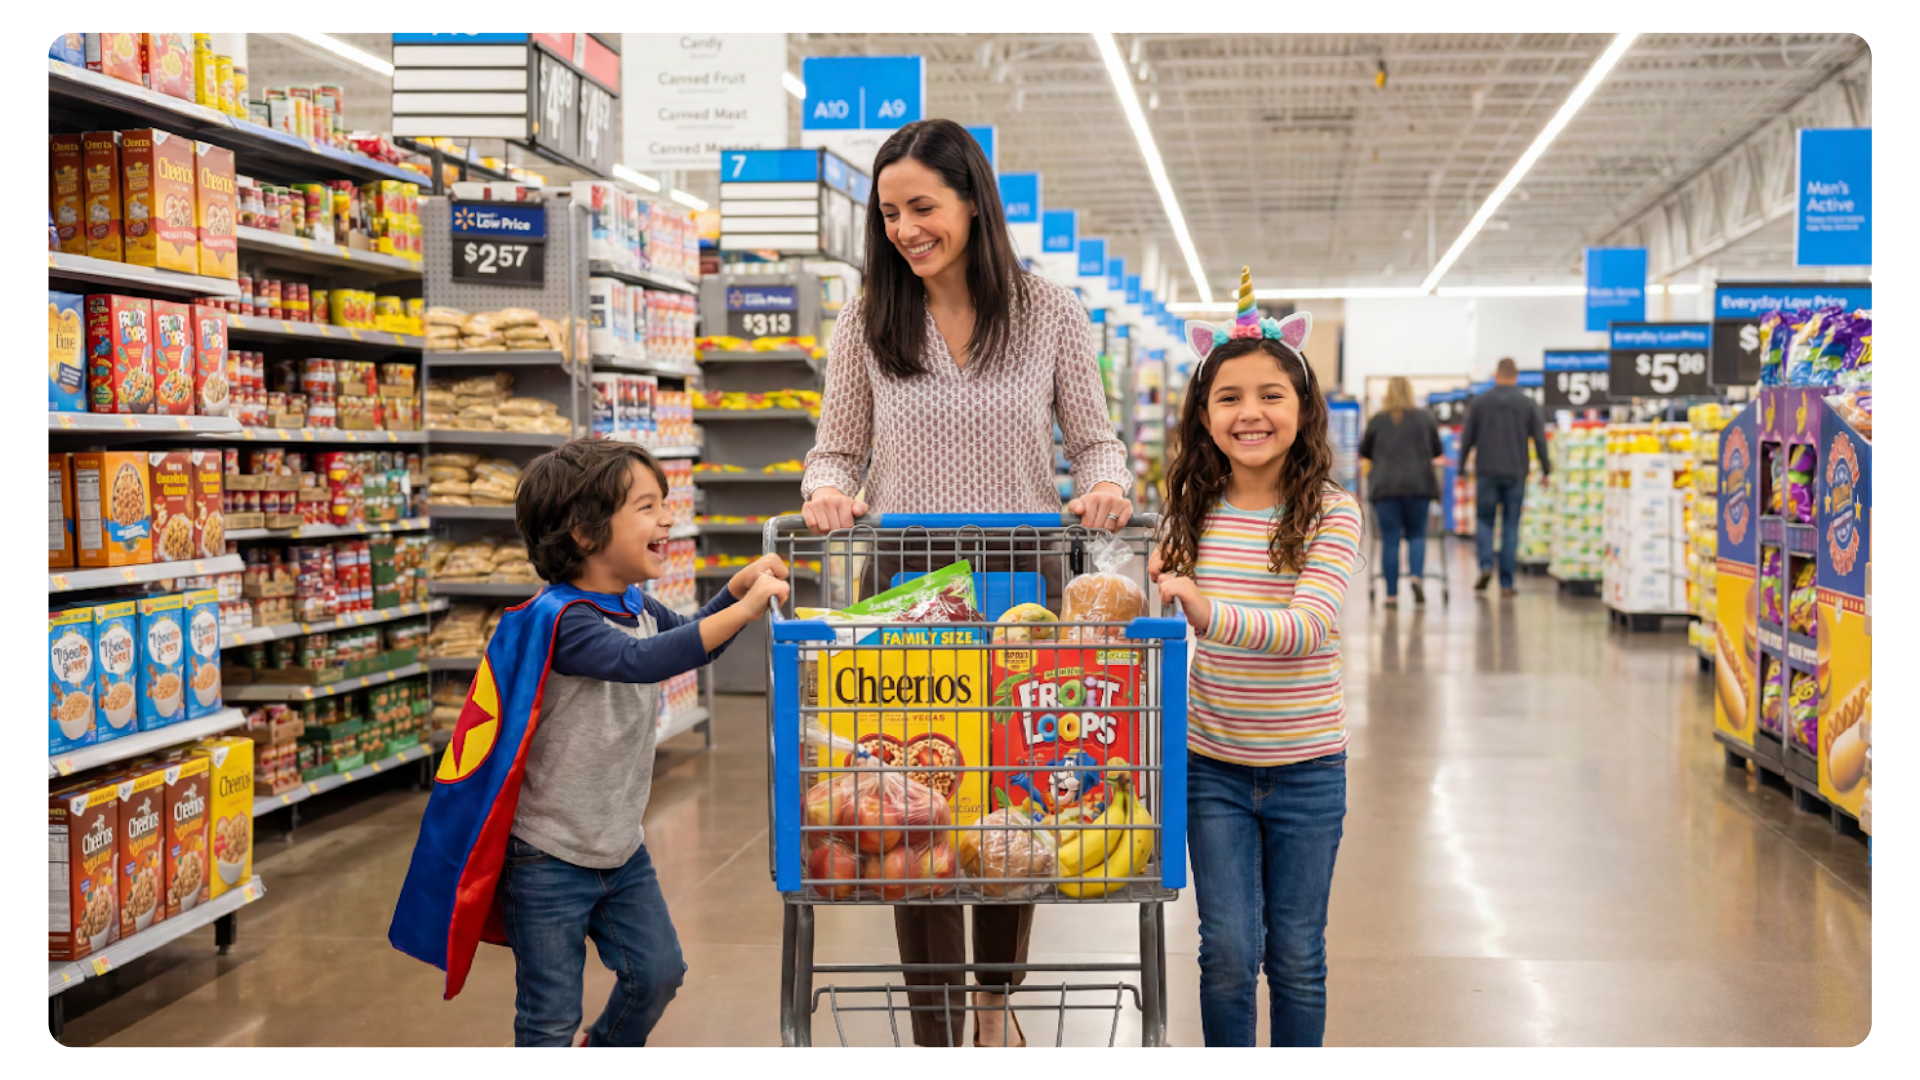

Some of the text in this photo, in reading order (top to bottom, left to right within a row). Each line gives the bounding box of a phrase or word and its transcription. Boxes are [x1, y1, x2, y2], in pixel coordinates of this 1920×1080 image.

[680, 35, 723, 51] Candy
[714, 70, 746, 85] Fruit
[813, 99, 850, 120] A10
[877, 98, 907, 119] A9
[731, 154, 747, 178] 7
[1806, 196, 1855, 213] Active
[476, 213, 531, 231] Low Price
[464, 241, 529, 274] $257
[1721, 294, 1782, 312] Everyday
[1784, 295, 1813, 309] Low
[882, 631, 973, 645] FAMILY SIZE
[835, 667, 972, 704] Cheerios
[1022, 711, 1118, 745] LOOPS
